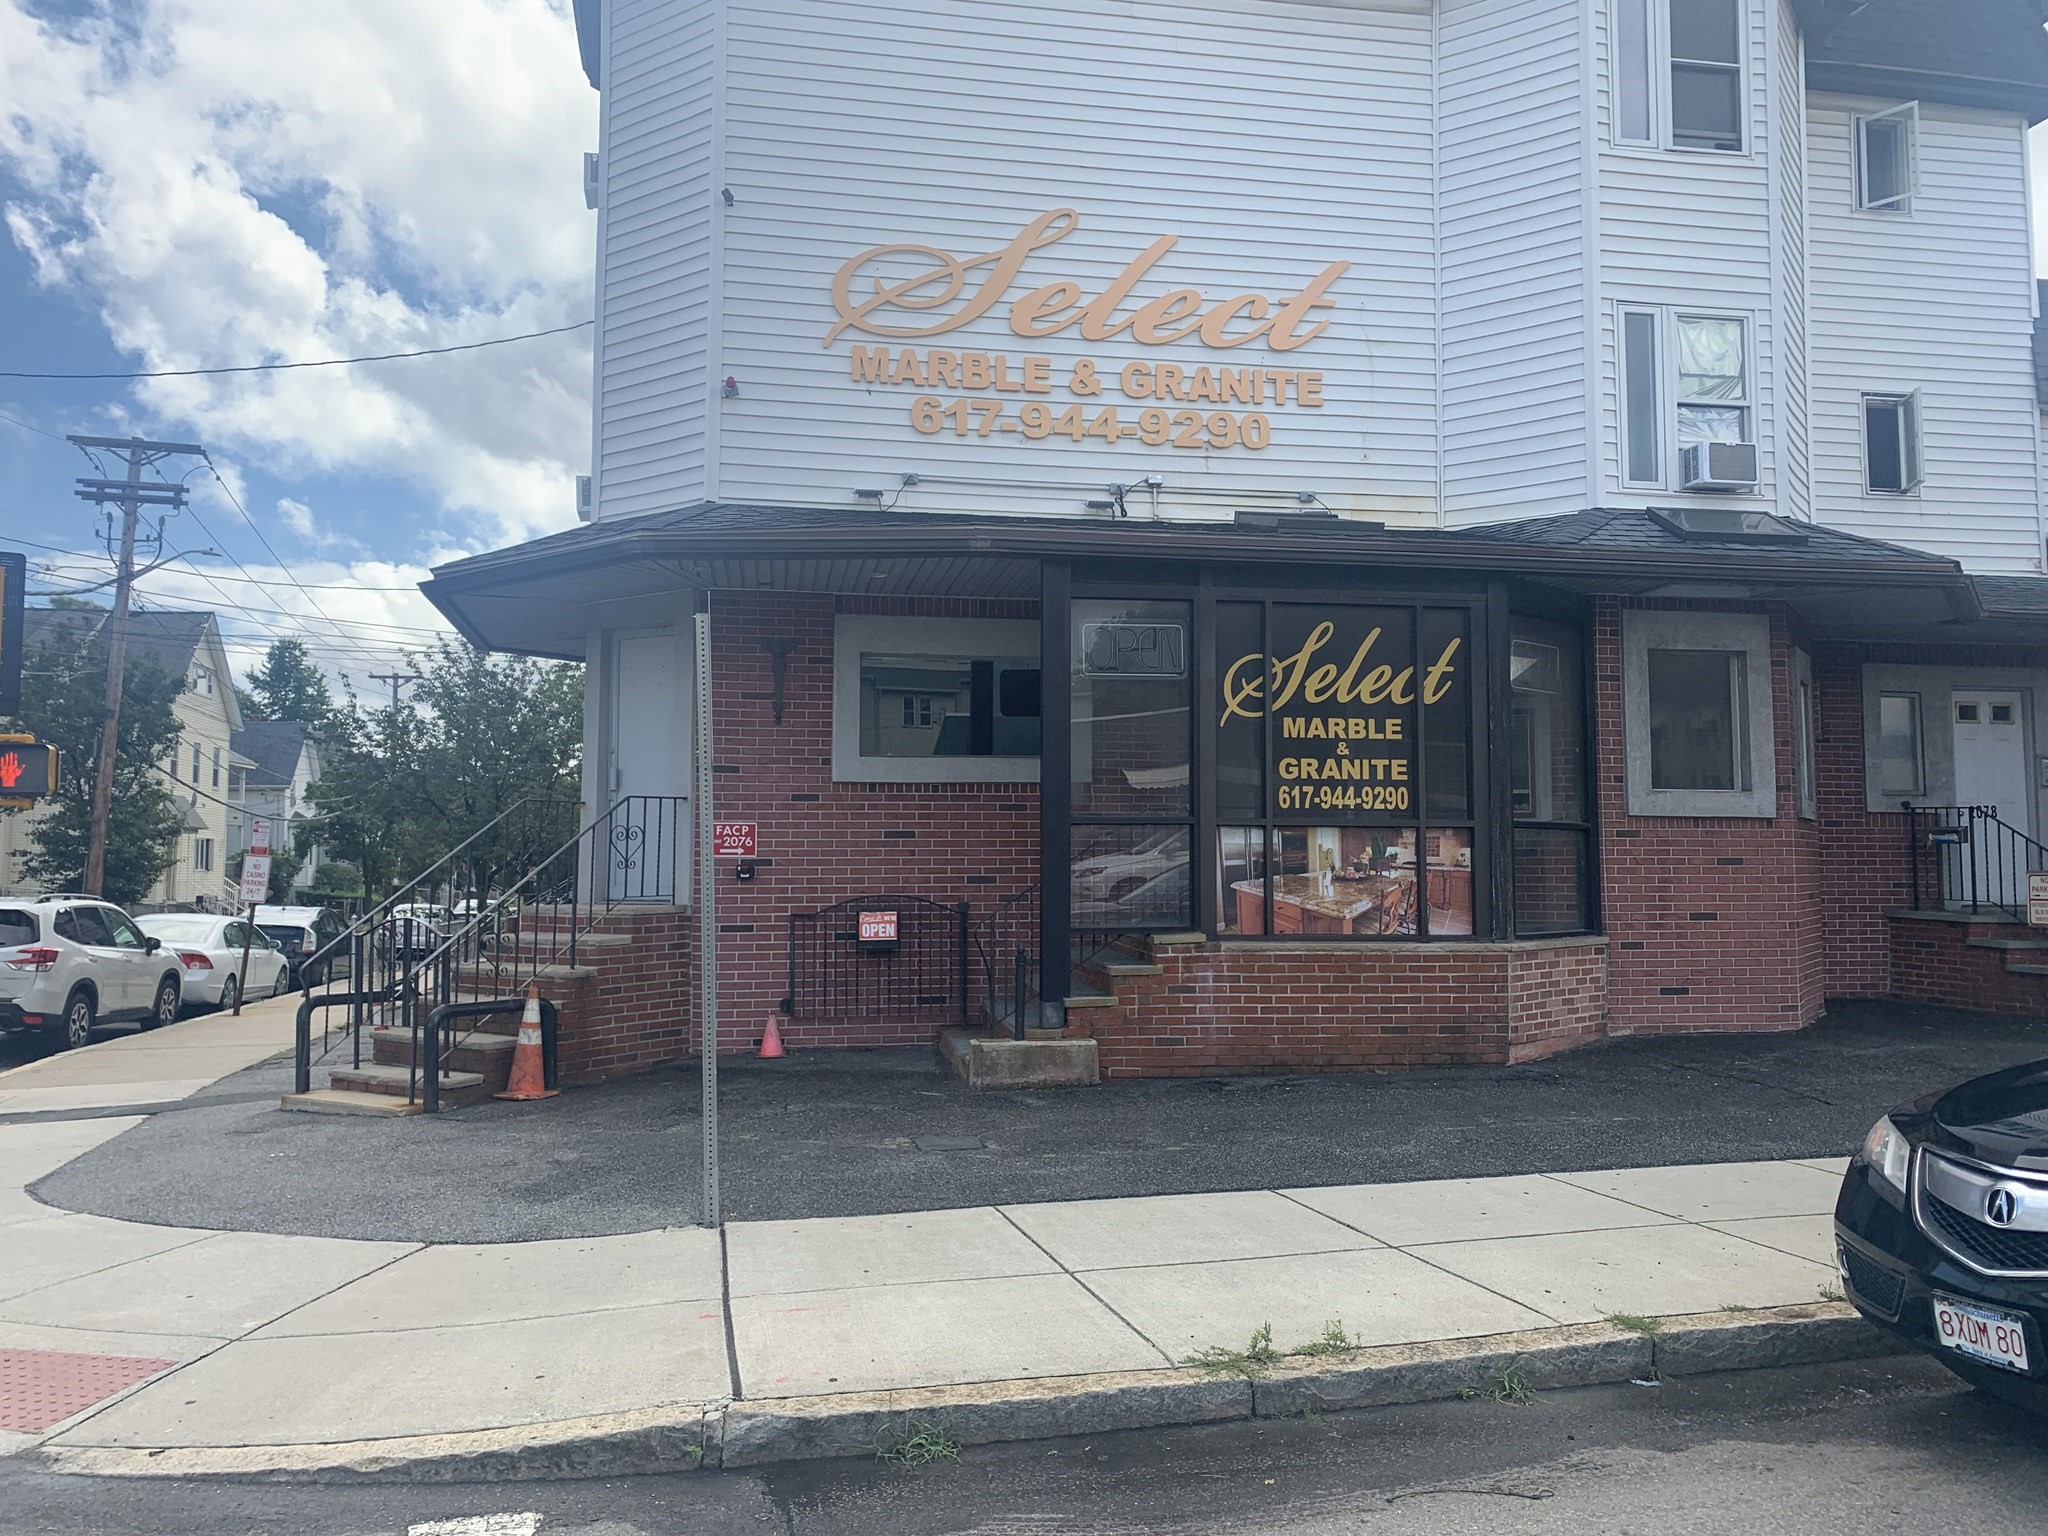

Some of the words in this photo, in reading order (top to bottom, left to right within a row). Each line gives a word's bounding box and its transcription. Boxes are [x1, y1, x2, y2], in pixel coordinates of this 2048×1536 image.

[823, 206, 1351, 351] Select
[851, 345, 1052, 393] MARBLE
[1070, 358, 1102, 396] &
[1121, 361, 1324, 407] GRANITE
[911, 395, 1271, 450] 617-944-9290
[1220, 621, 1461, 727] Select
[1283, 717, 1403, 740] MARBLE
[1336, 741, 1350, 756] &
[1278, 758, 1409, 781] GRANITE
[1278, 785, 1409, 810] 617-944-9290
[716, 825, 749, 836] FACP
[723, 836, 753, 847] 2076
[243, 878, 266, 887] PARKING
[246, 870, 266, 879] CASINO
[246, 887, 261, 895] 24/7
[861, 923, 895, 937] OPEN
[1939, 1310, 1992, 1350] 8XDM
[1995, 1325, 2023, 1358] 80
